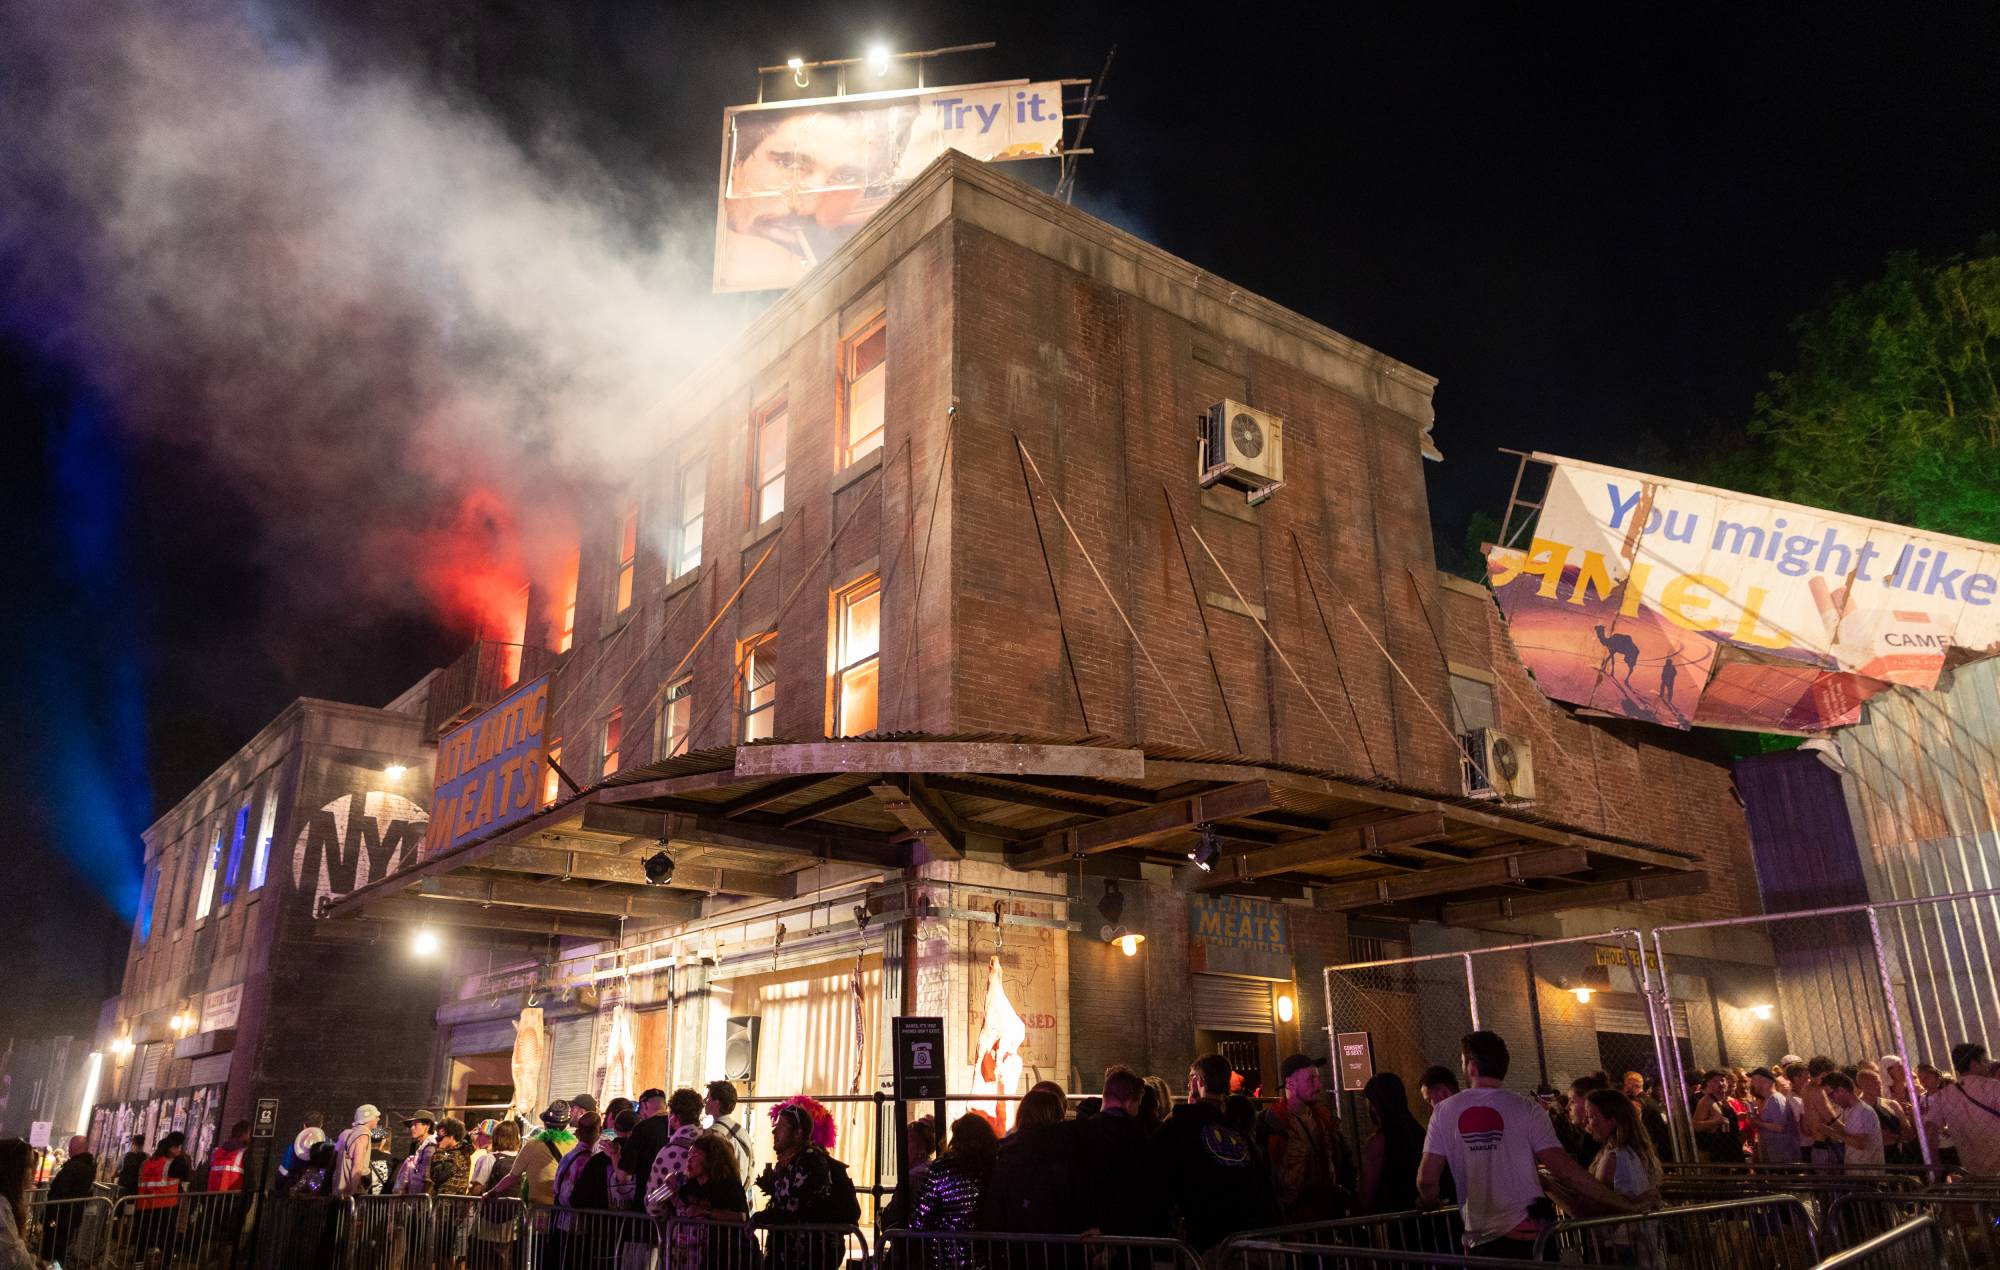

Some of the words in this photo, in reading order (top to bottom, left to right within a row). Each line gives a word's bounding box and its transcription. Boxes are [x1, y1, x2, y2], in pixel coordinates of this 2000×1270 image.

[932, 97, 1002, 134] Try
[1015, 91, 1058, 124] it.
[1606, 482, 1699, 544] You
[1711, 517, 1880, 577] might
[1889, 543, 1999, 606] like
[434, 682, 549, 790] ATLANTIC
[424, 749, 542, 850] MEATS
[1198, 911, 1281, 944] MEATS
